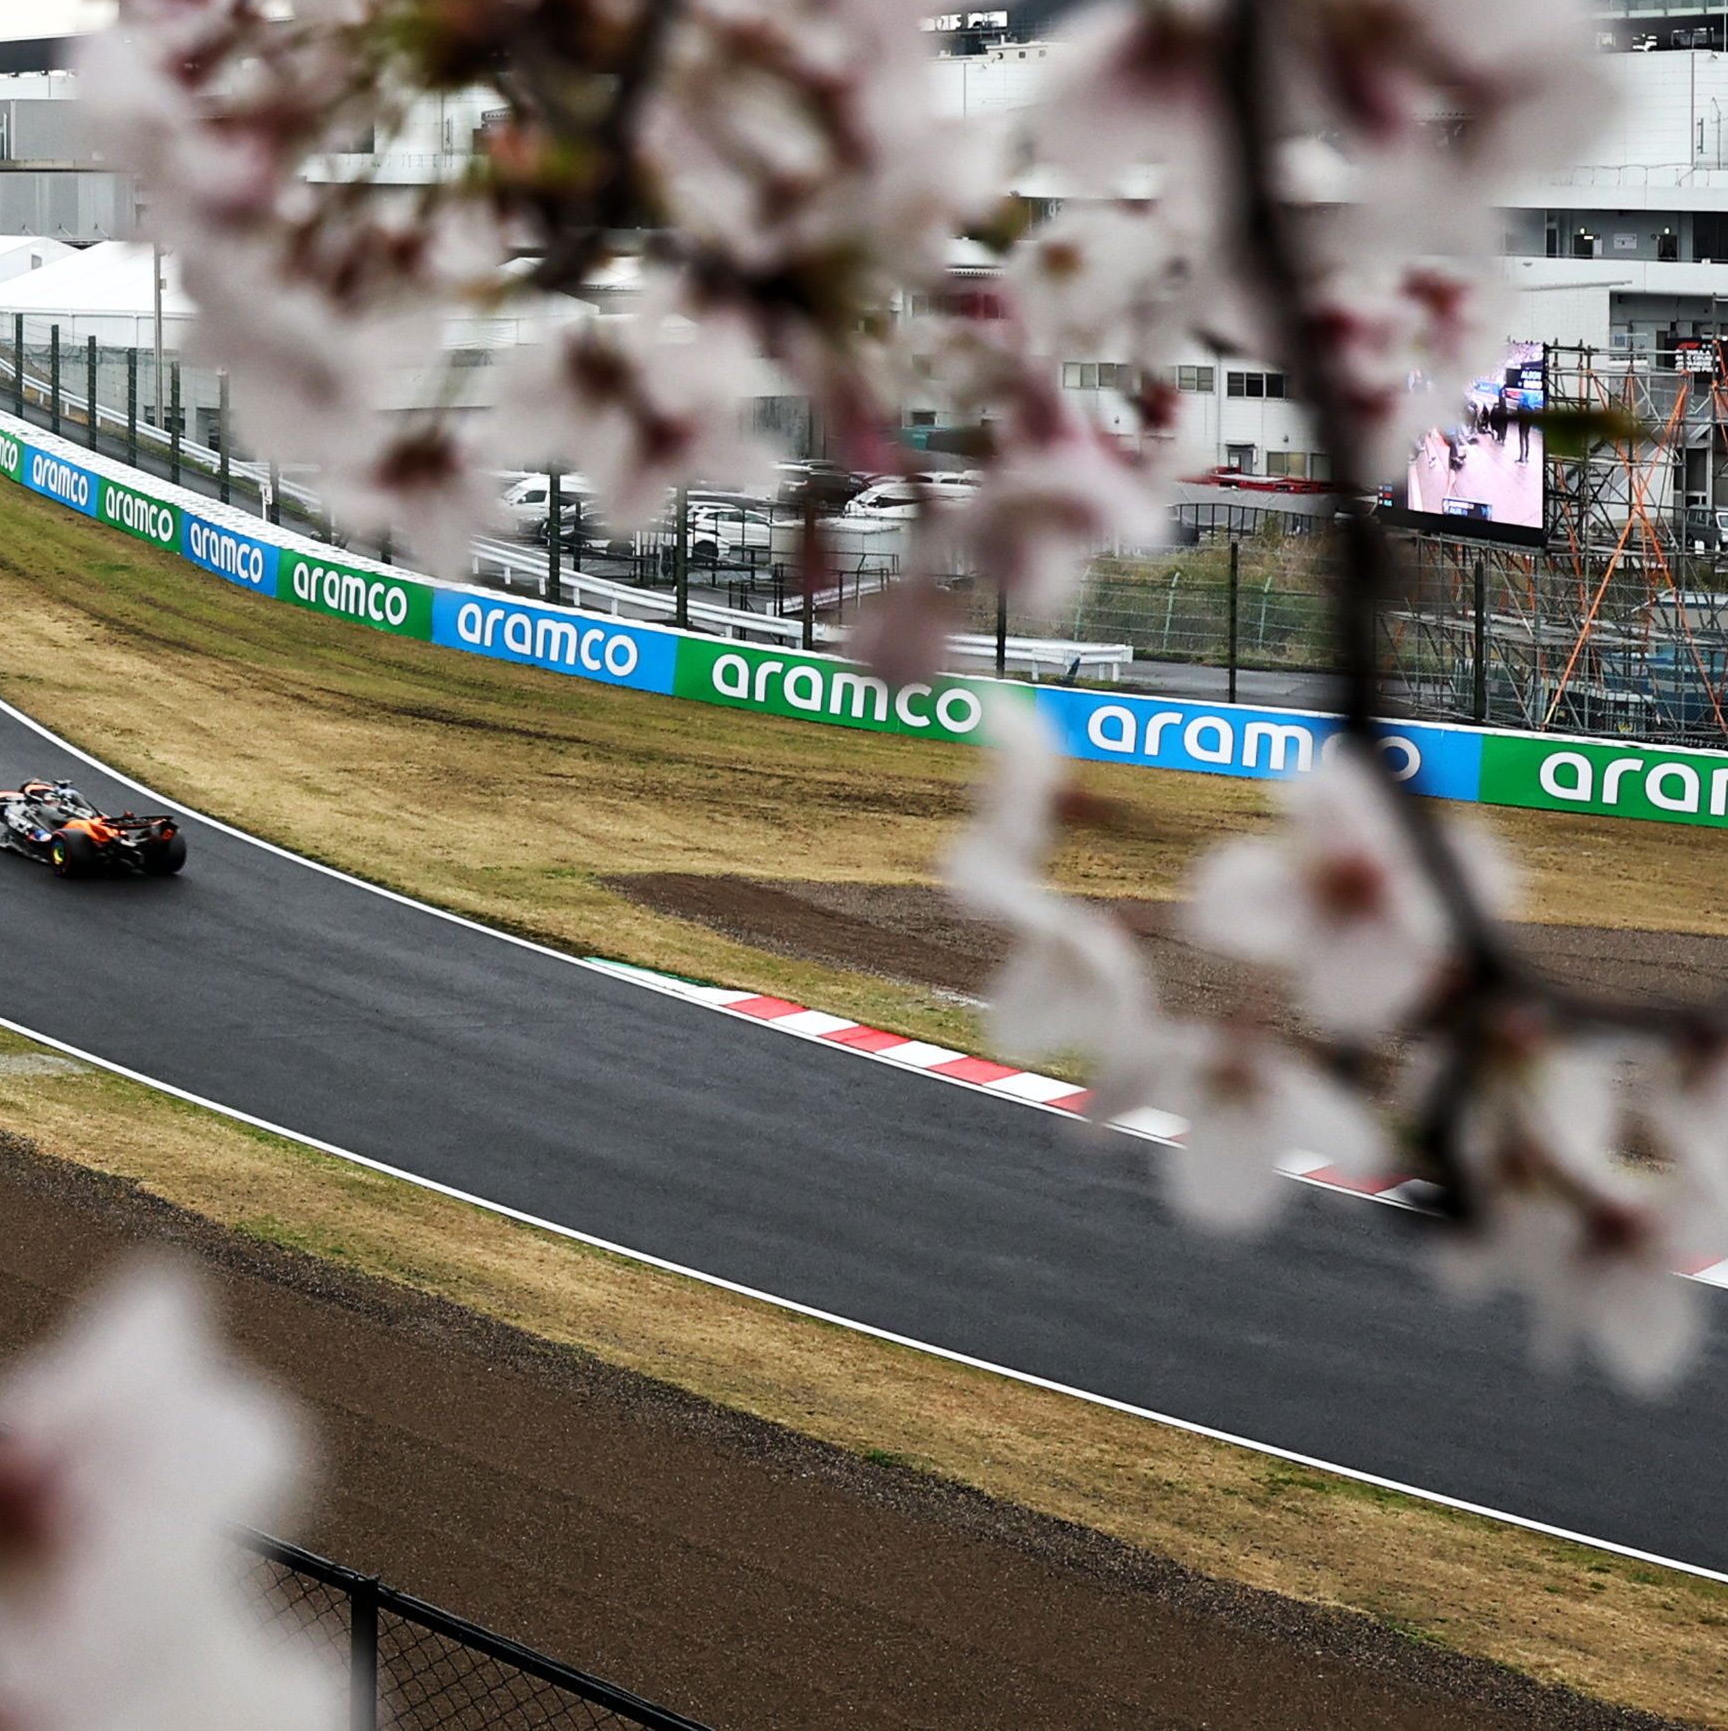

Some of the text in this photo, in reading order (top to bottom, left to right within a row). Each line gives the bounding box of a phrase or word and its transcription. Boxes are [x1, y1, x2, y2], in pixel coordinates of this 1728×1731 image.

[32, 452, 89, 506] aramco
[105, 484, 174, 544] aramco
[189, 521, 264, 585] aramco
[292, 560, 408, 627] aramco
[457, 602, 639, 678] aramco
[712, 653, 983, 734] aramco
[1540, 751, 1728, 816] ara
